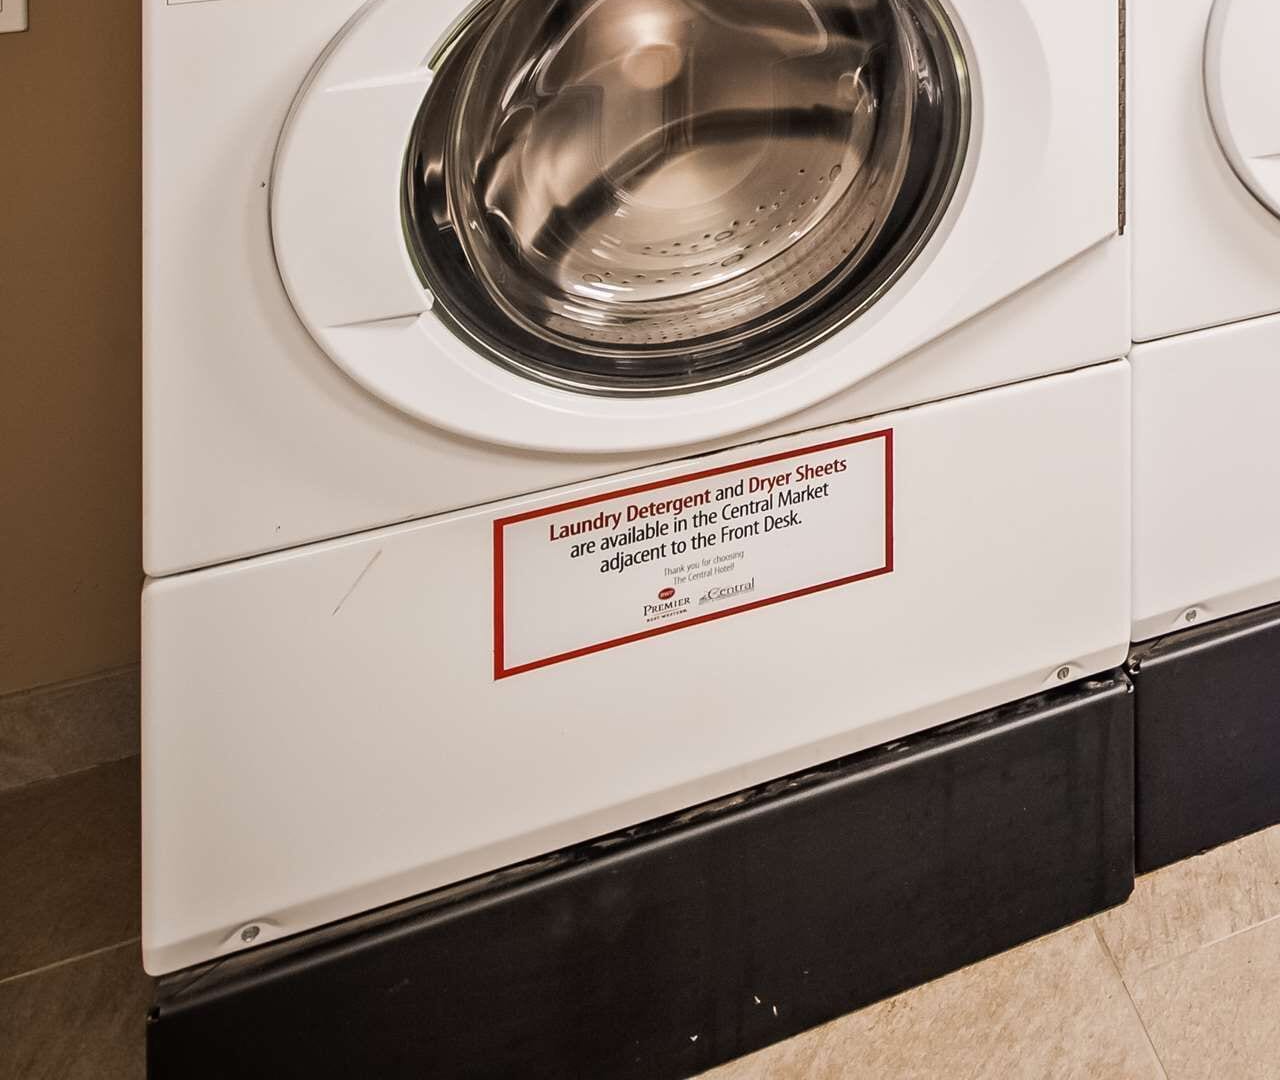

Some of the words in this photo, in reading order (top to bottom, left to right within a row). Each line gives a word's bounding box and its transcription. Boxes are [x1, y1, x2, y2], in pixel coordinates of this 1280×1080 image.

[550, 512, 622, 541] Laundry
[626, 489, 712, 522] Detergent
[715, 479, 744, 501] and
[749, 472, 792, 494] Dryer
[795, 458, 847, 482] Sheets
[570, 541, 596, 558] are
[600, 520, 669, 550] available
[673, 517, 687, 533] in
[692, 510, 717, 528] the
[722, 494, 773, 520] Central
[778, 482, 829, 508] Market
[600, 543, 667, 573] adjacent
[671, 540, 687, 555] to
[691, 532, 716, 550] the
[721, 521, 760, 544] Front
[764, 510, 802, 532] Desk.
[664, 566, 685, 577] Thank
[686, 561, 700, 571] you
[701, 558, 711, 566] for
[712, 550, 745, 563] choosing
[673, 576, 687, 585] The
[688, 568, 713, 581] Central
[708, 577, 754, 600] Central
[643, 597, 691, 616] PREMIER
